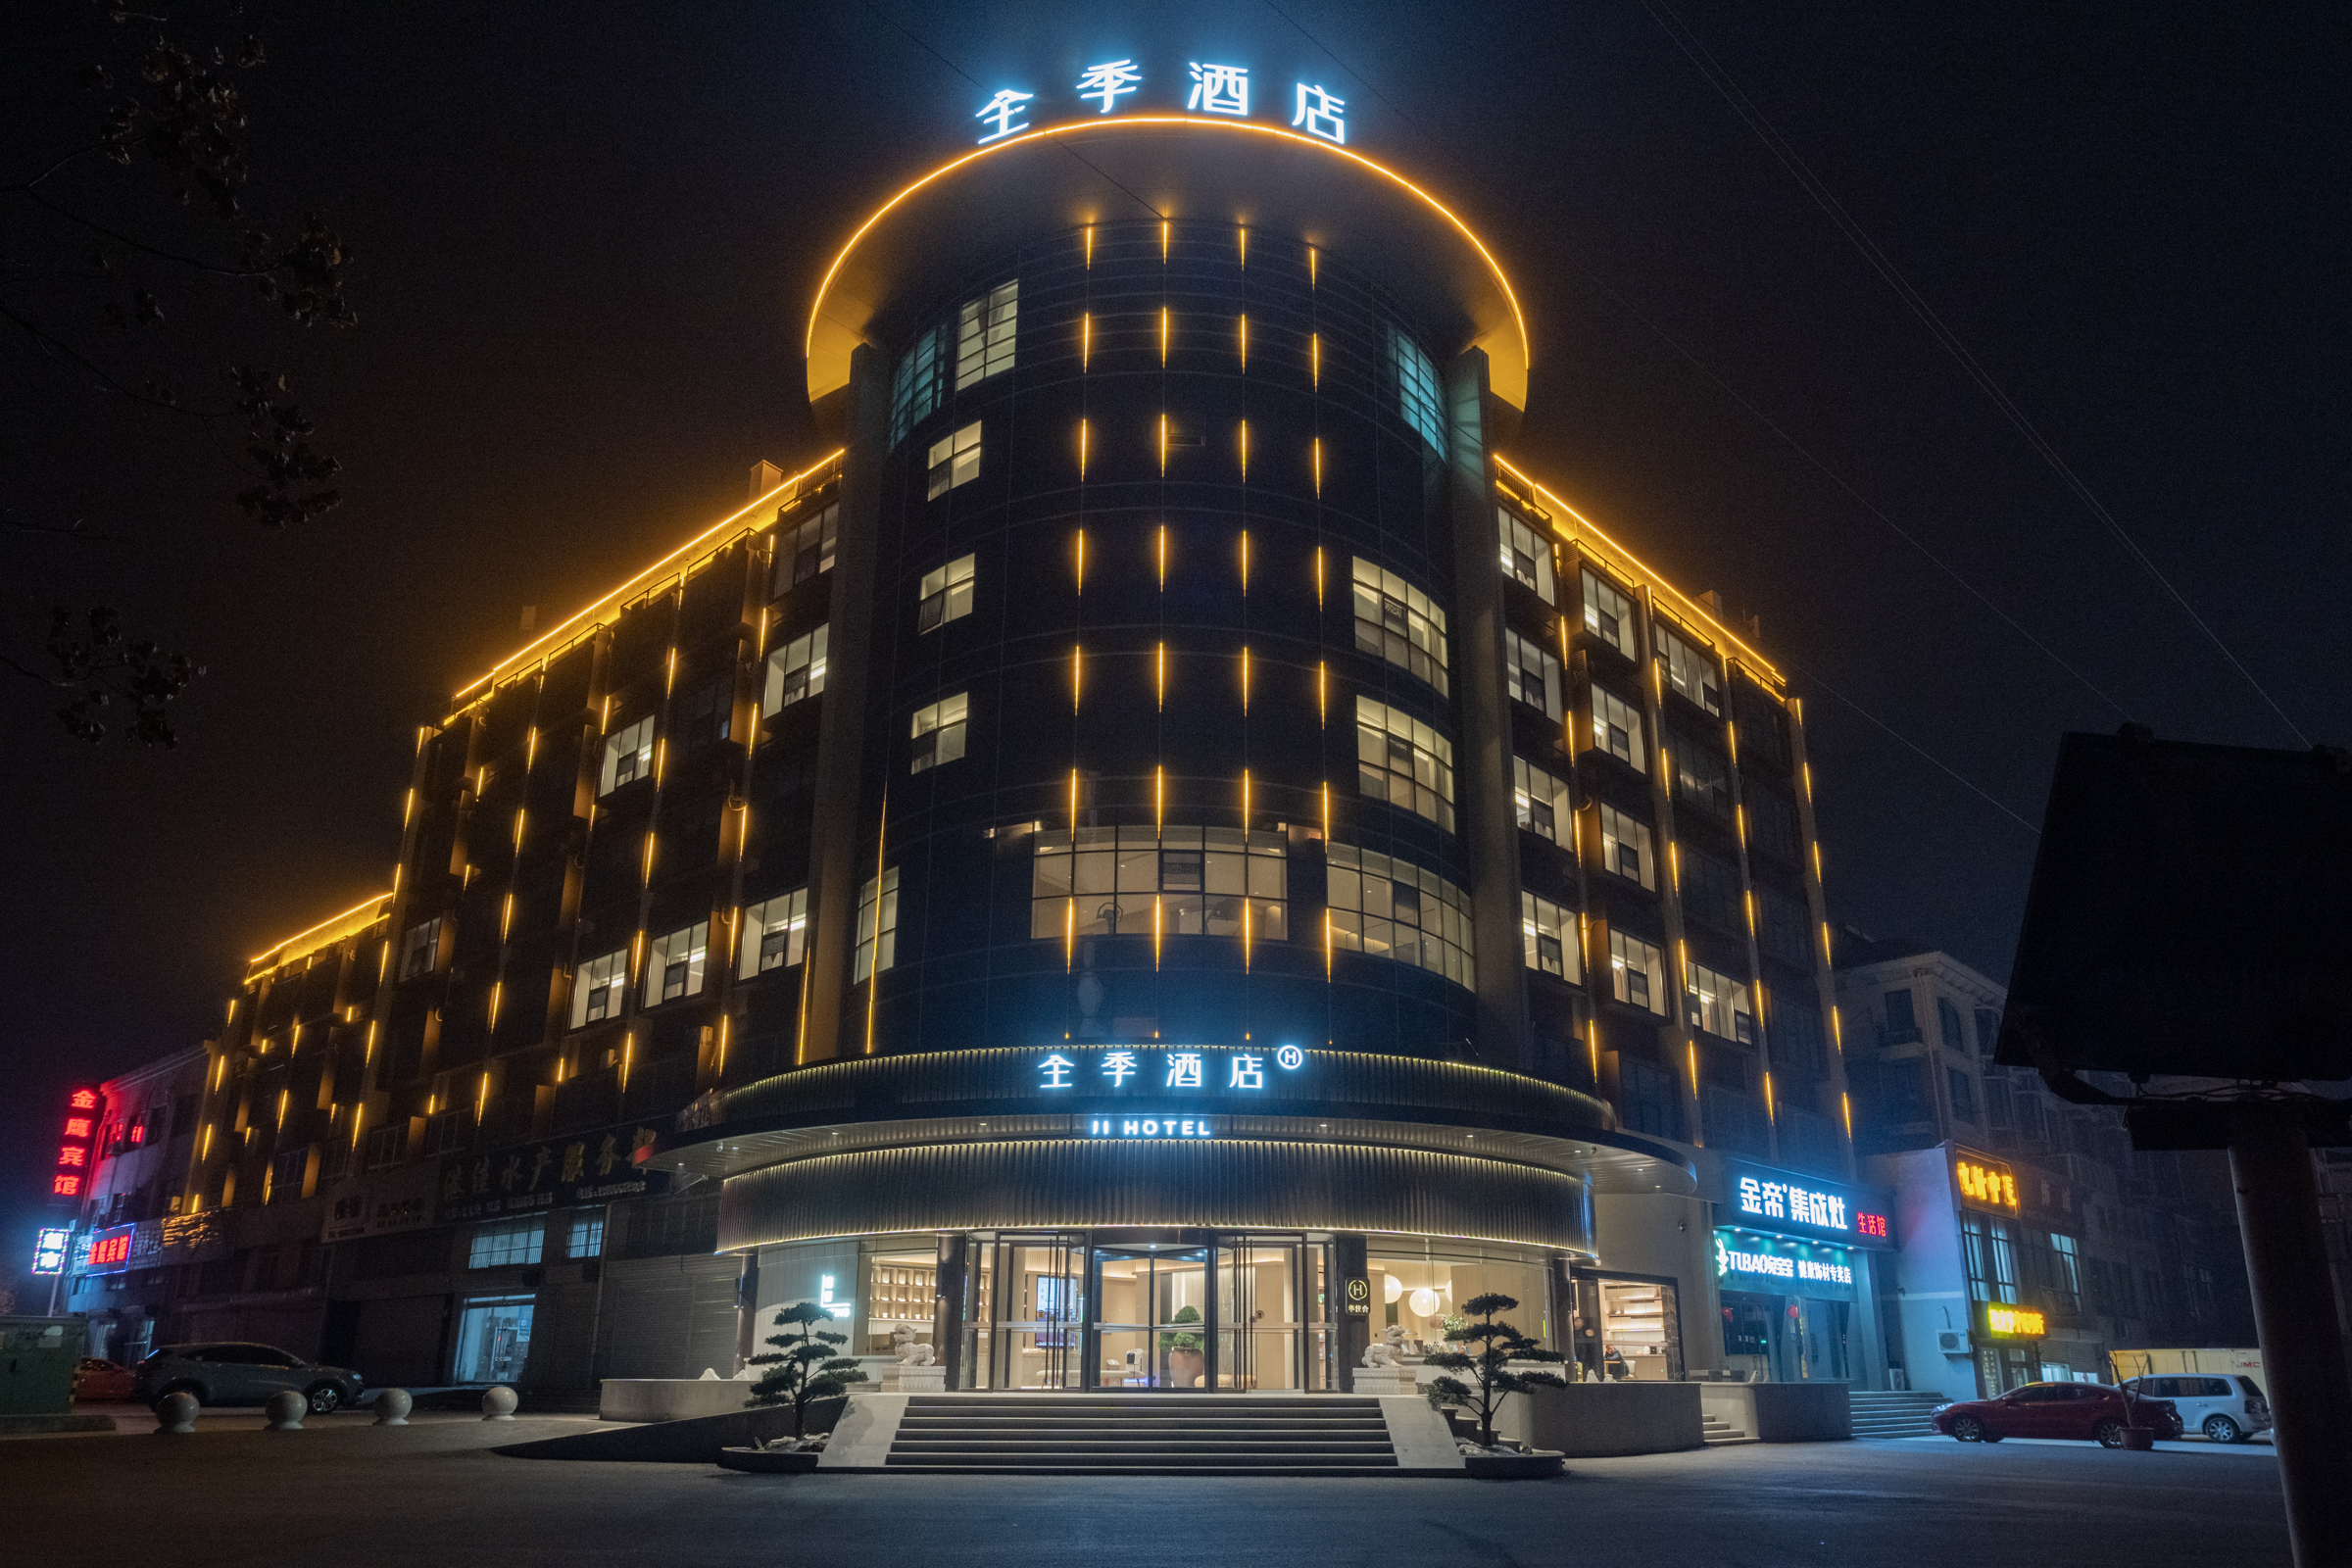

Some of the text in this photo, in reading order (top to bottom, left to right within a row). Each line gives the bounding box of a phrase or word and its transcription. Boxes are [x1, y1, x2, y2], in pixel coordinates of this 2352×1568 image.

[975, 59, 1346, 145] 全季酒店
[1038, 1052, 1263, 1089] 全季酒店
[54, 1089, 96, 1196] 金鹰宾馆
[1123, 1119, 1210, 1136] HOTEL
[1740, 1177, 1848, 1230] 金帝集成灶
[1857, 1211, 1886, 1237] 生活馆
[87, 1235, 129, 1265] 金鹰宾馆
